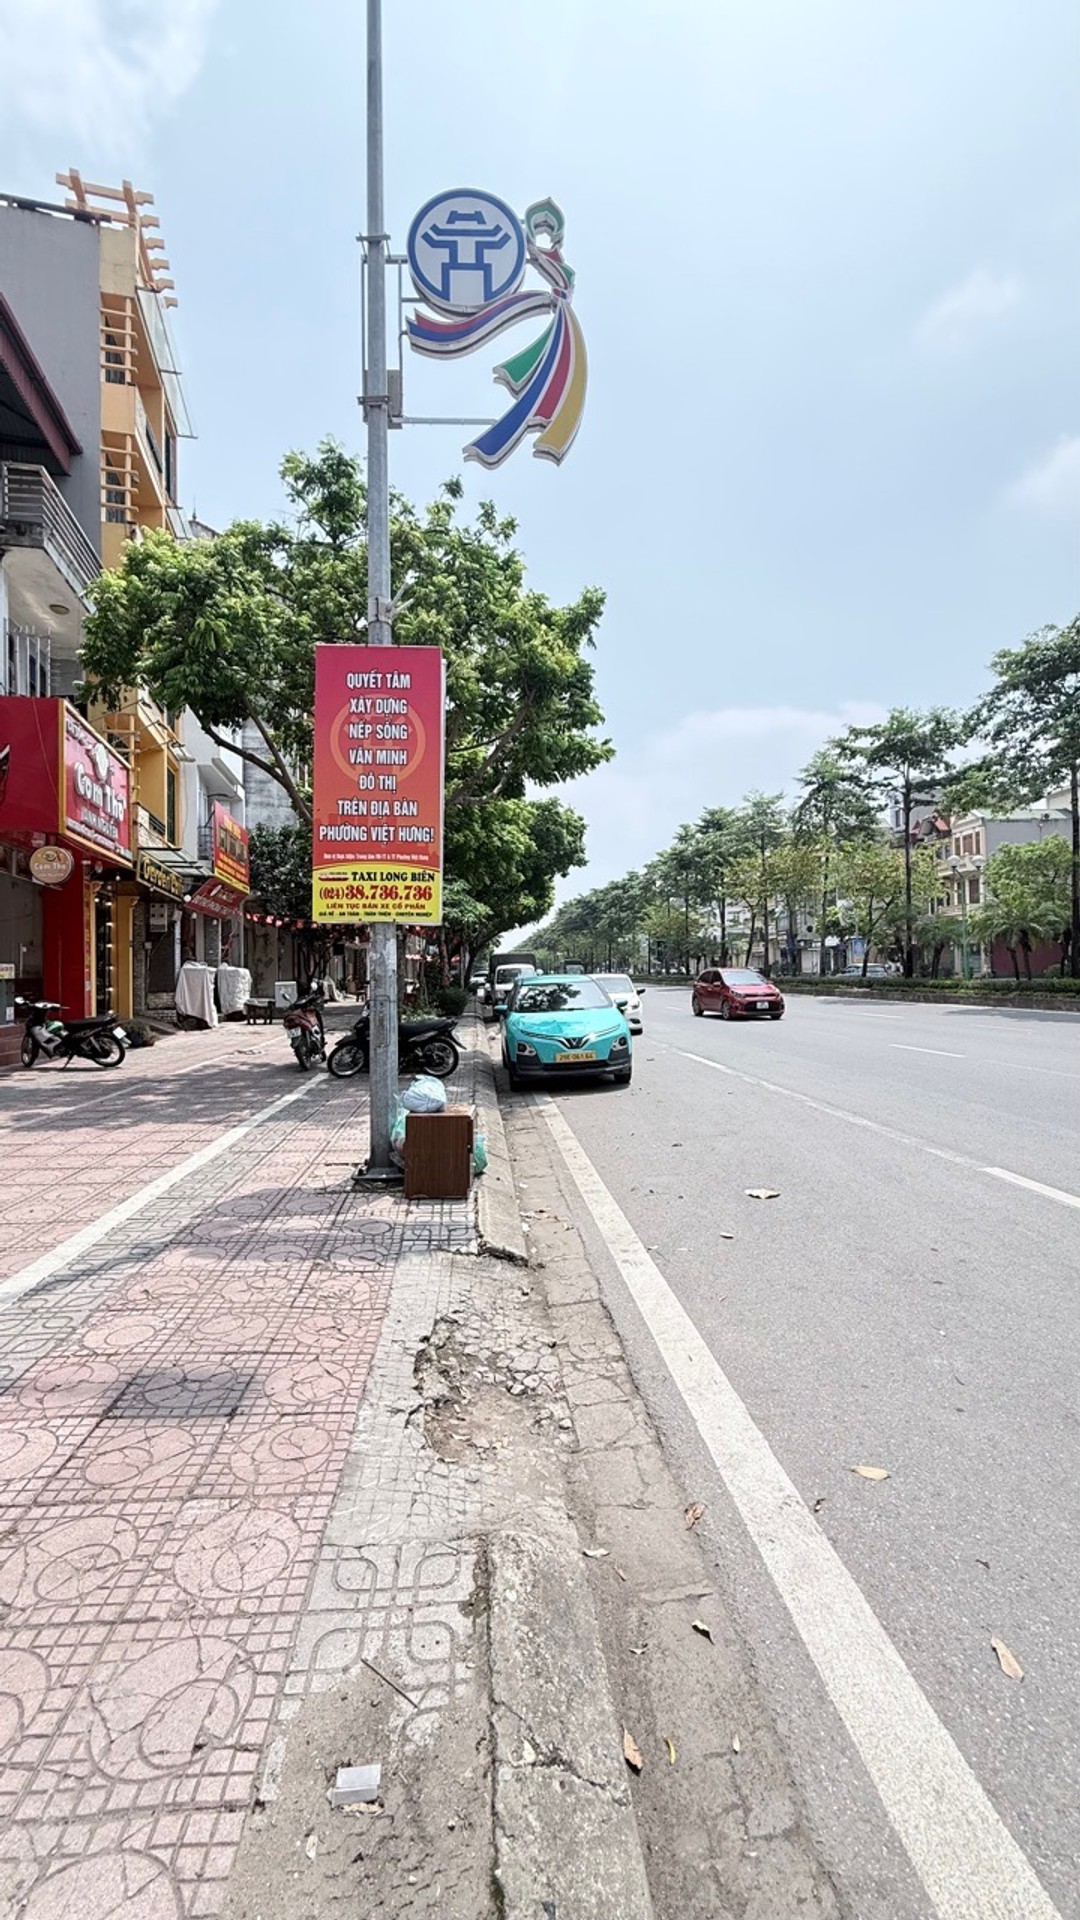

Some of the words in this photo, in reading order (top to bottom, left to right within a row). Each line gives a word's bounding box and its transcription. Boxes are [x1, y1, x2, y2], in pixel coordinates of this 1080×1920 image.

[347, 669, 383, 689] QUYẾT
[386, 671, 411, 689] TÂM
[349, 695, 372, 714] XÂY
[375, 697, 408, 717] DỰNG
[349, 720, 372, 739] NẾP
[376, 719, 408, 739] SỐNG
[349, 747, 372, 764] VĂN
[376, 749, 407, 765] MINH
[359, 772, 375, 790] ĐÔ
[378, 775, 396, 794] THỊ
[337, 797, 367, 816] TRÊN
[370, 800, 390, 818] ĐỊA
[393, 798, 417, 816] BÀN
[319, 822, 367, 841] PHƯỜNG
[370, 824, 395, 845] VIỆT
[398, 825, 434, 842] HƯNG!
[351, 871, 377, 882] TAXI
[380, 871, 408, 882] LONG
[411, 870, 435, 882] BIÊN
[326, 902, 343, 910] LIÊN
[346, 902, 361, 910] TỤC
[405, 902, 425, 910] PHẦN
